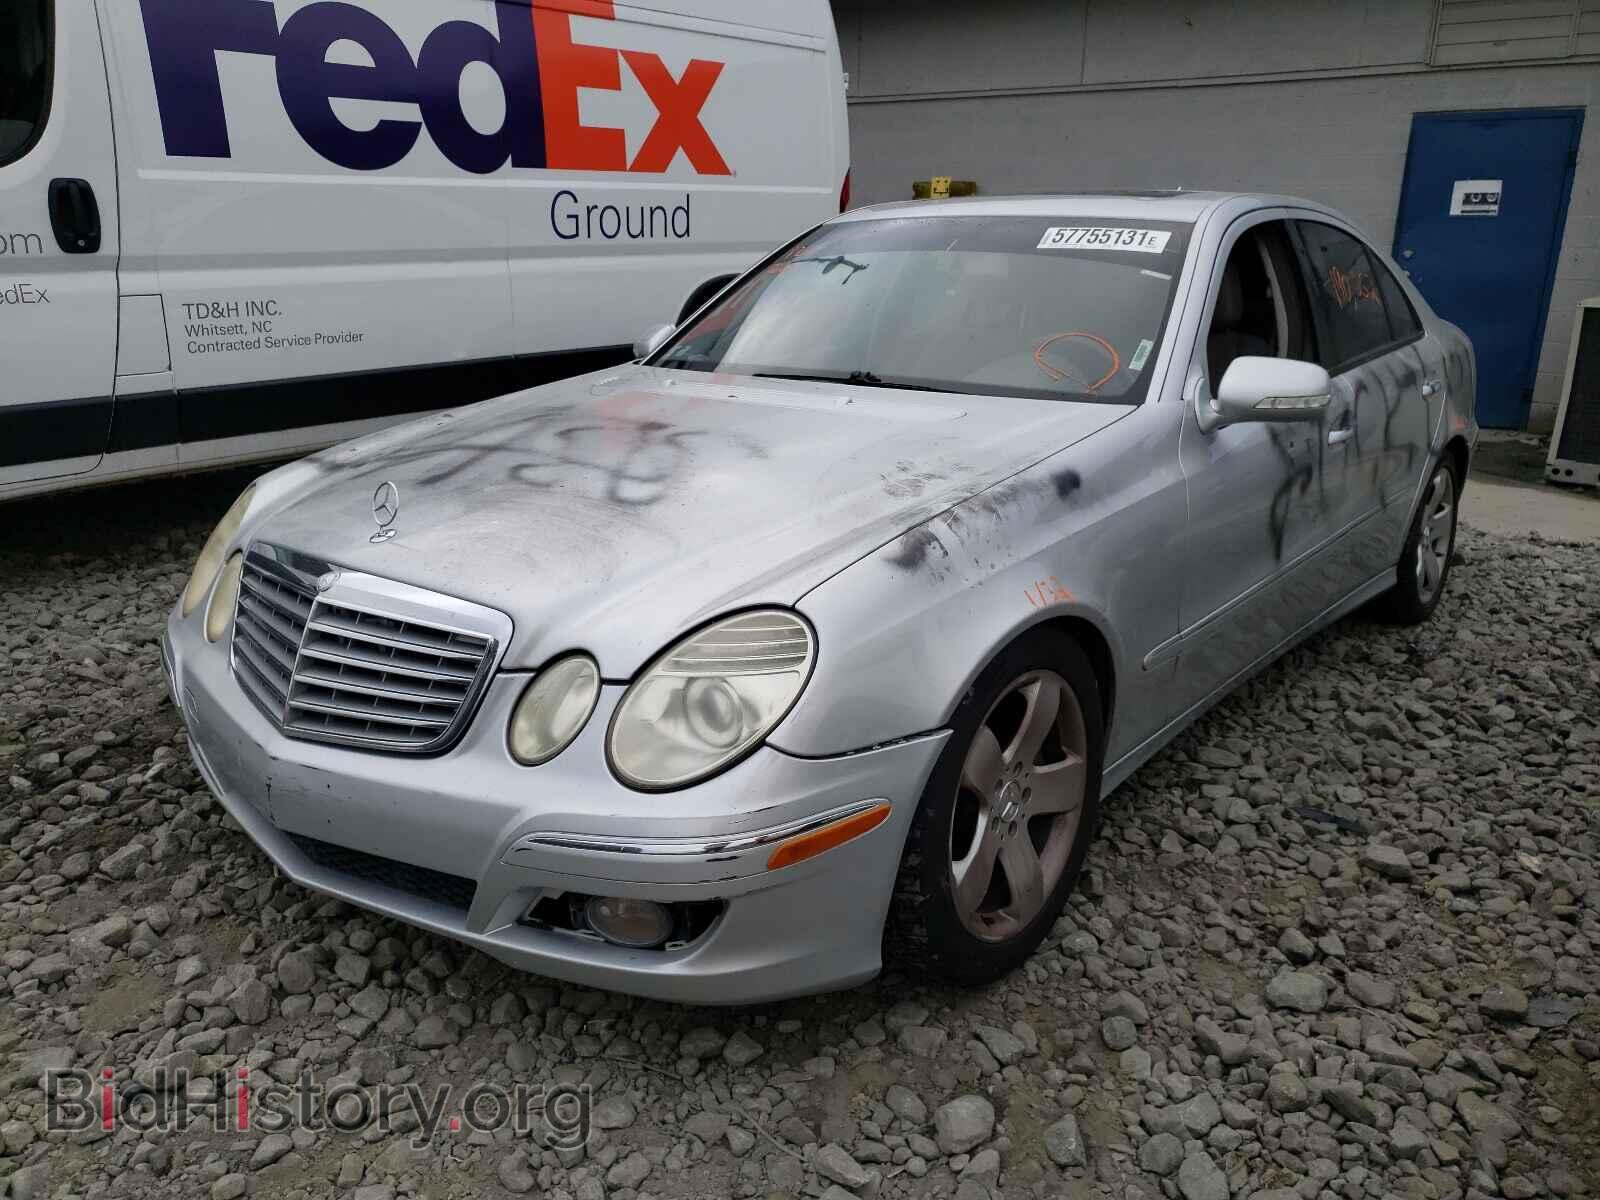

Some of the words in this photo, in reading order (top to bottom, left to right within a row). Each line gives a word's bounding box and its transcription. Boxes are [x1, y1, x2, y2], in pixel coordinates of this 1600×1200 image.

[550, 190, 692, 241] Ground
[1052, 228, 1148, 246] 57755131
[0, 283, 50, 304] dEx
[182, 302, 240, 320] TD&H
[245, 299, 282, 317] INC.
[185, 323, 248, 337] Whitsett,
[252, 321, 272, 333] NC
[187, 338, 261, 354] Contracted
[264, 334, 311, 349] Service
[314, 331, 364, 345] Provider
